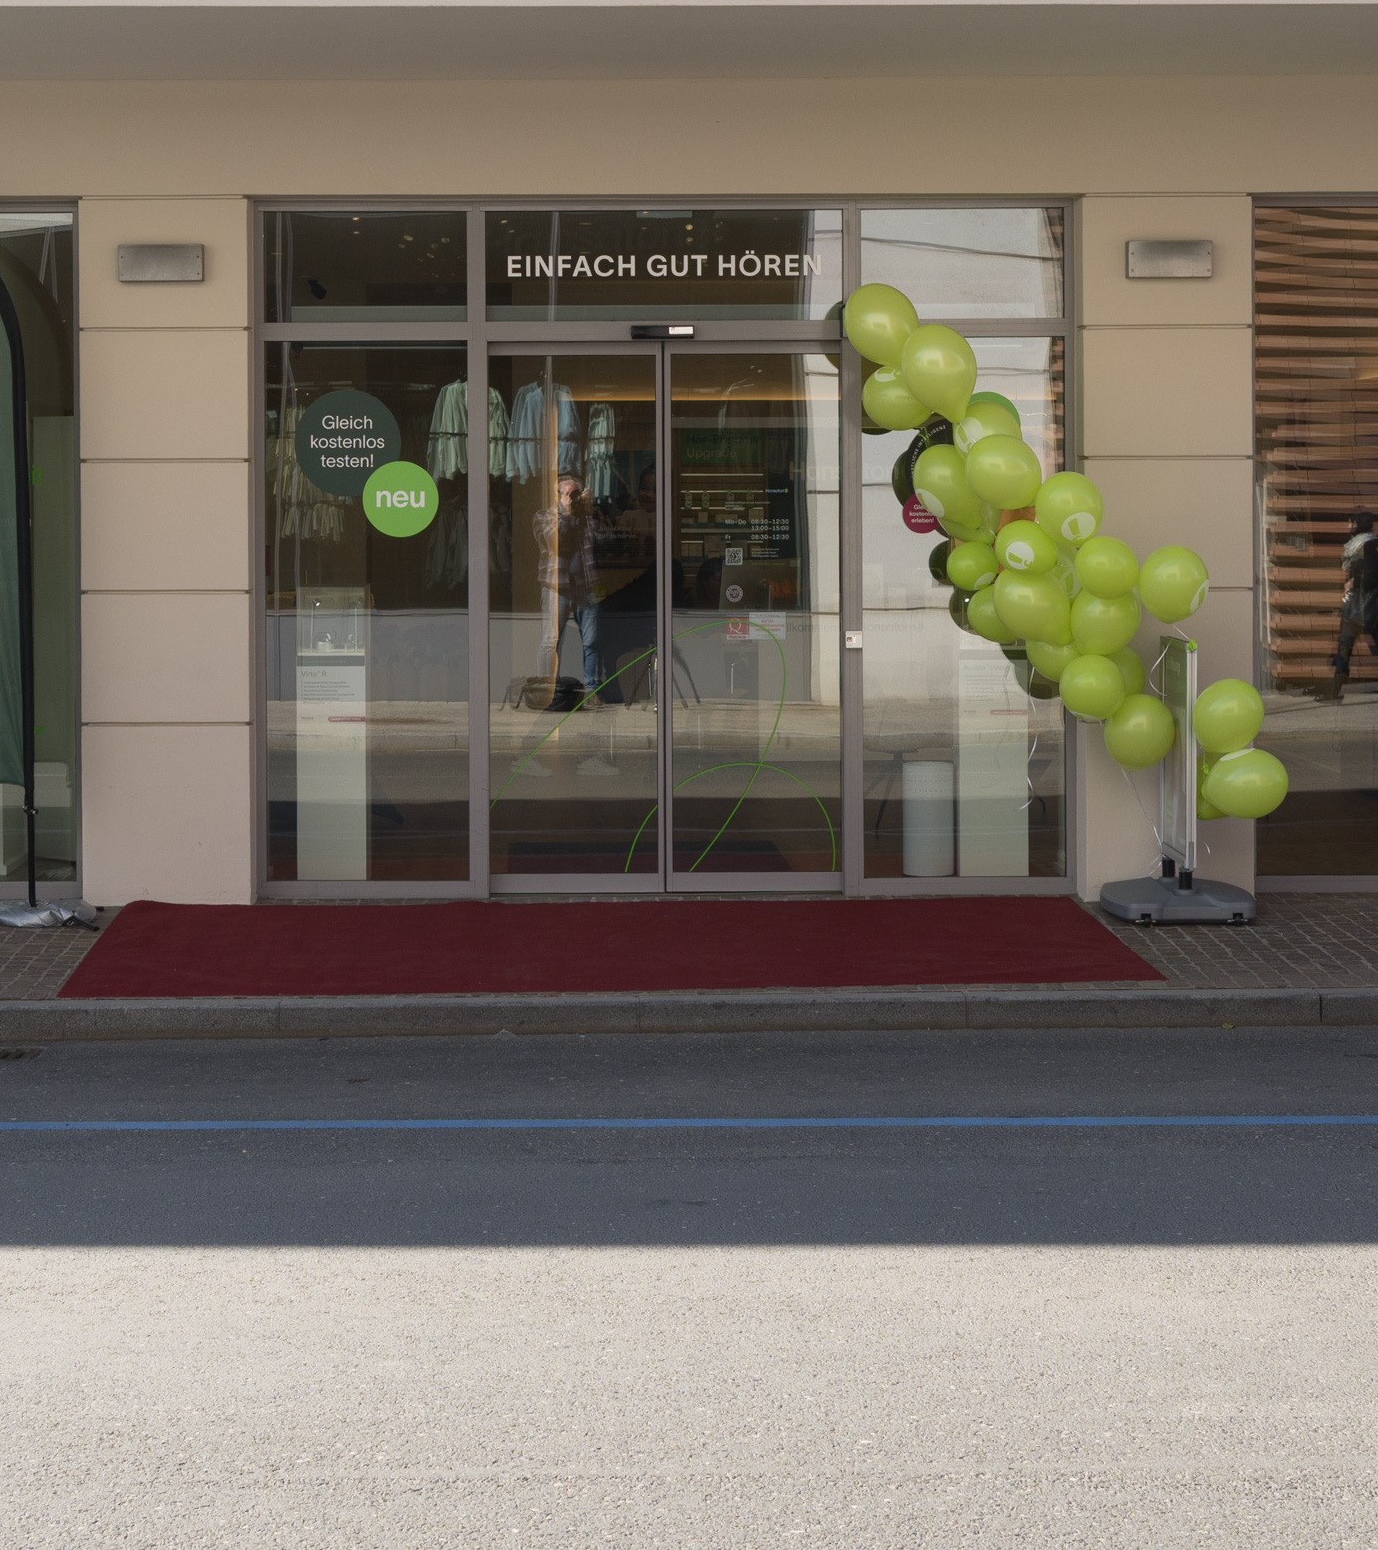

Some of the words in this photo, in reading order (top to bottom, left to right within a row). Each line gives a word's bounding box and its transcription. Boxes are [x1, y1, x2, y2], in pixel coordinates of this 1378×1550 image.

[507, 254, 636, 278] EINFACH
[646, 254, 708, 277] GUT
[718, 249, 822, 277] HÖREN
[321, 415, 373, 430] Gleich
[310, 434, 385, 449] kostenlos
[320, 453, 374, 468] testen!
[686, 448, 737, 460] Upgrade
[375, 489, 426, 508] neu
